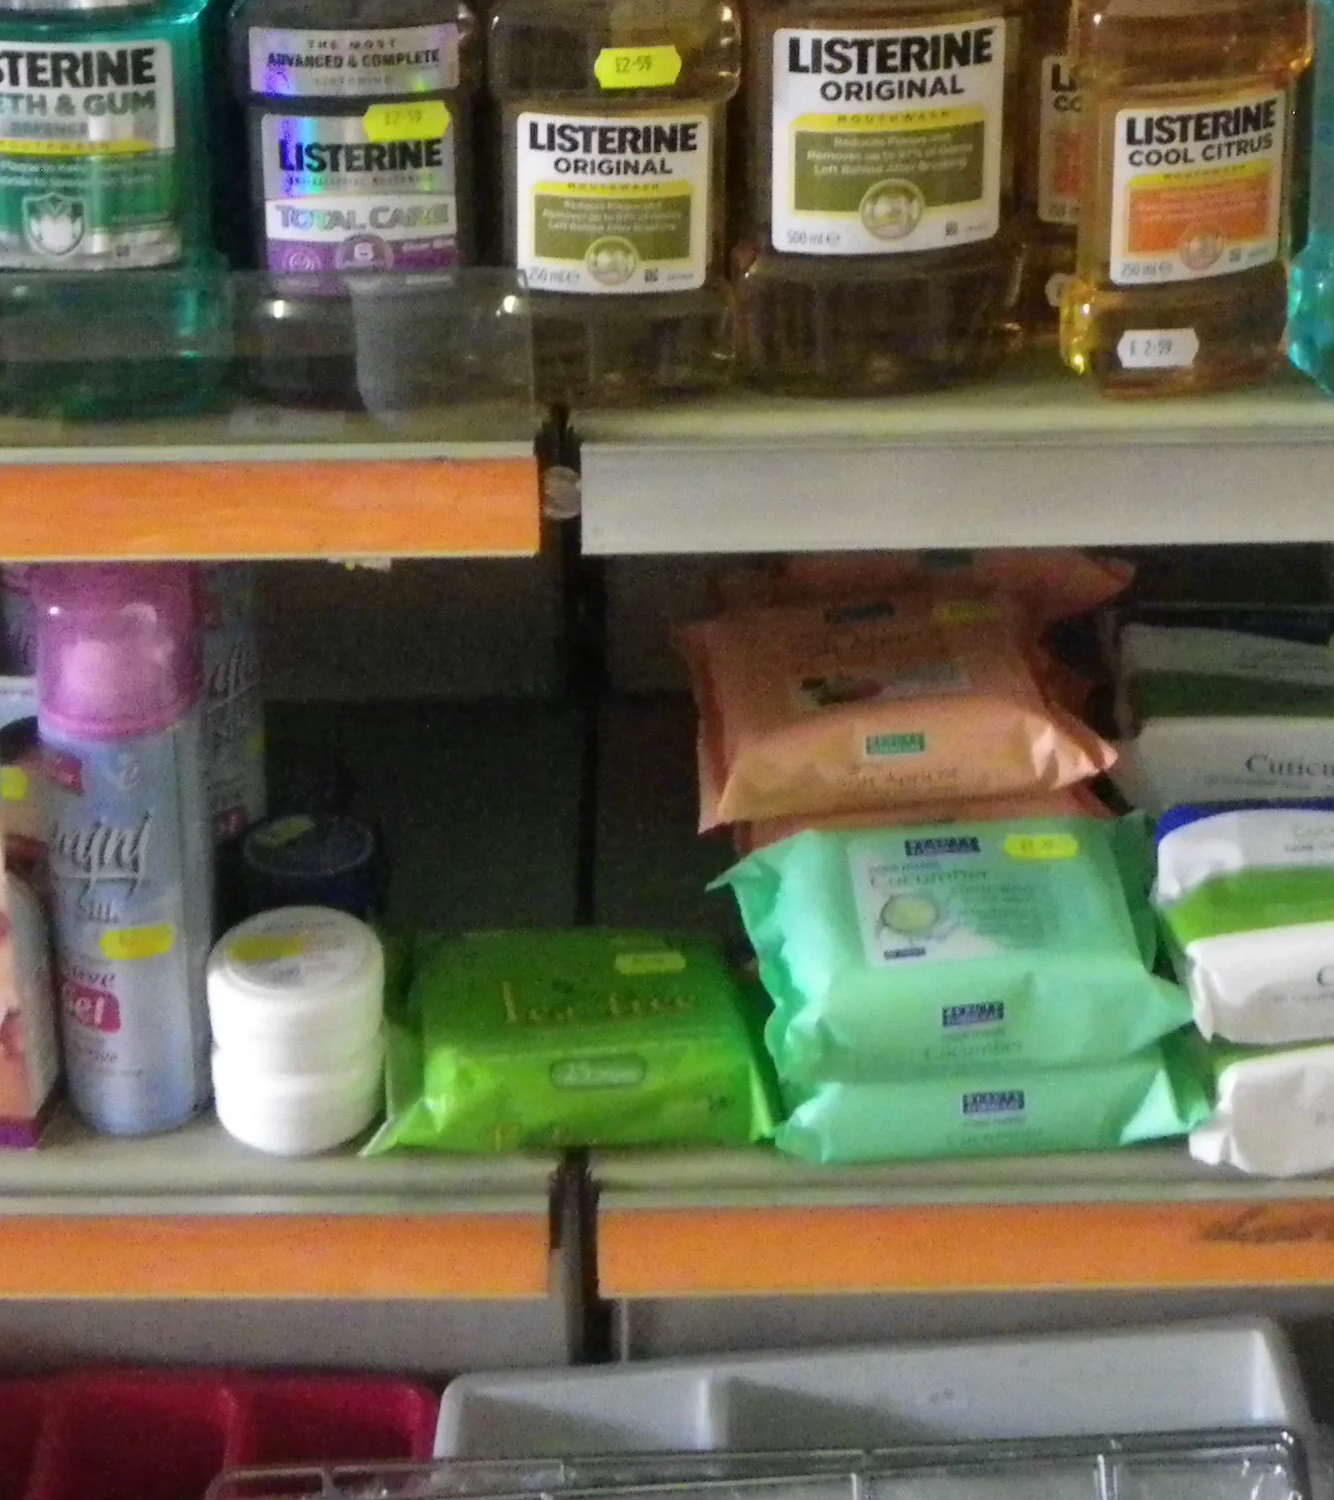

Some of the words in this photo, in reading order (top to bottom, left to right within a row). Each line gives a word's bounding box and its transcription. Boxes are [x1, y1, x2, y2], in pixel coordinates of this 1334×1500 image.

[788, 27, 994, 75] LISTERINE
[83, 89, 156, 116] GUM
[820, 75, 966, 102] ORIGINAL
[529, 122, 699, 155] LISTERINE
[1126, 99, 1278, 146] LISTERINE
[278, 138, 442, 173] LISTERINE
[553, 157, 673, 176] ORIGINAL
[1128, 147, 1197, 168] COOL
[1201, 133, 1273, 162] CITRUS
[275, 204, 369, 231] TOTAL
[370, 202, 449, 230] CARE
